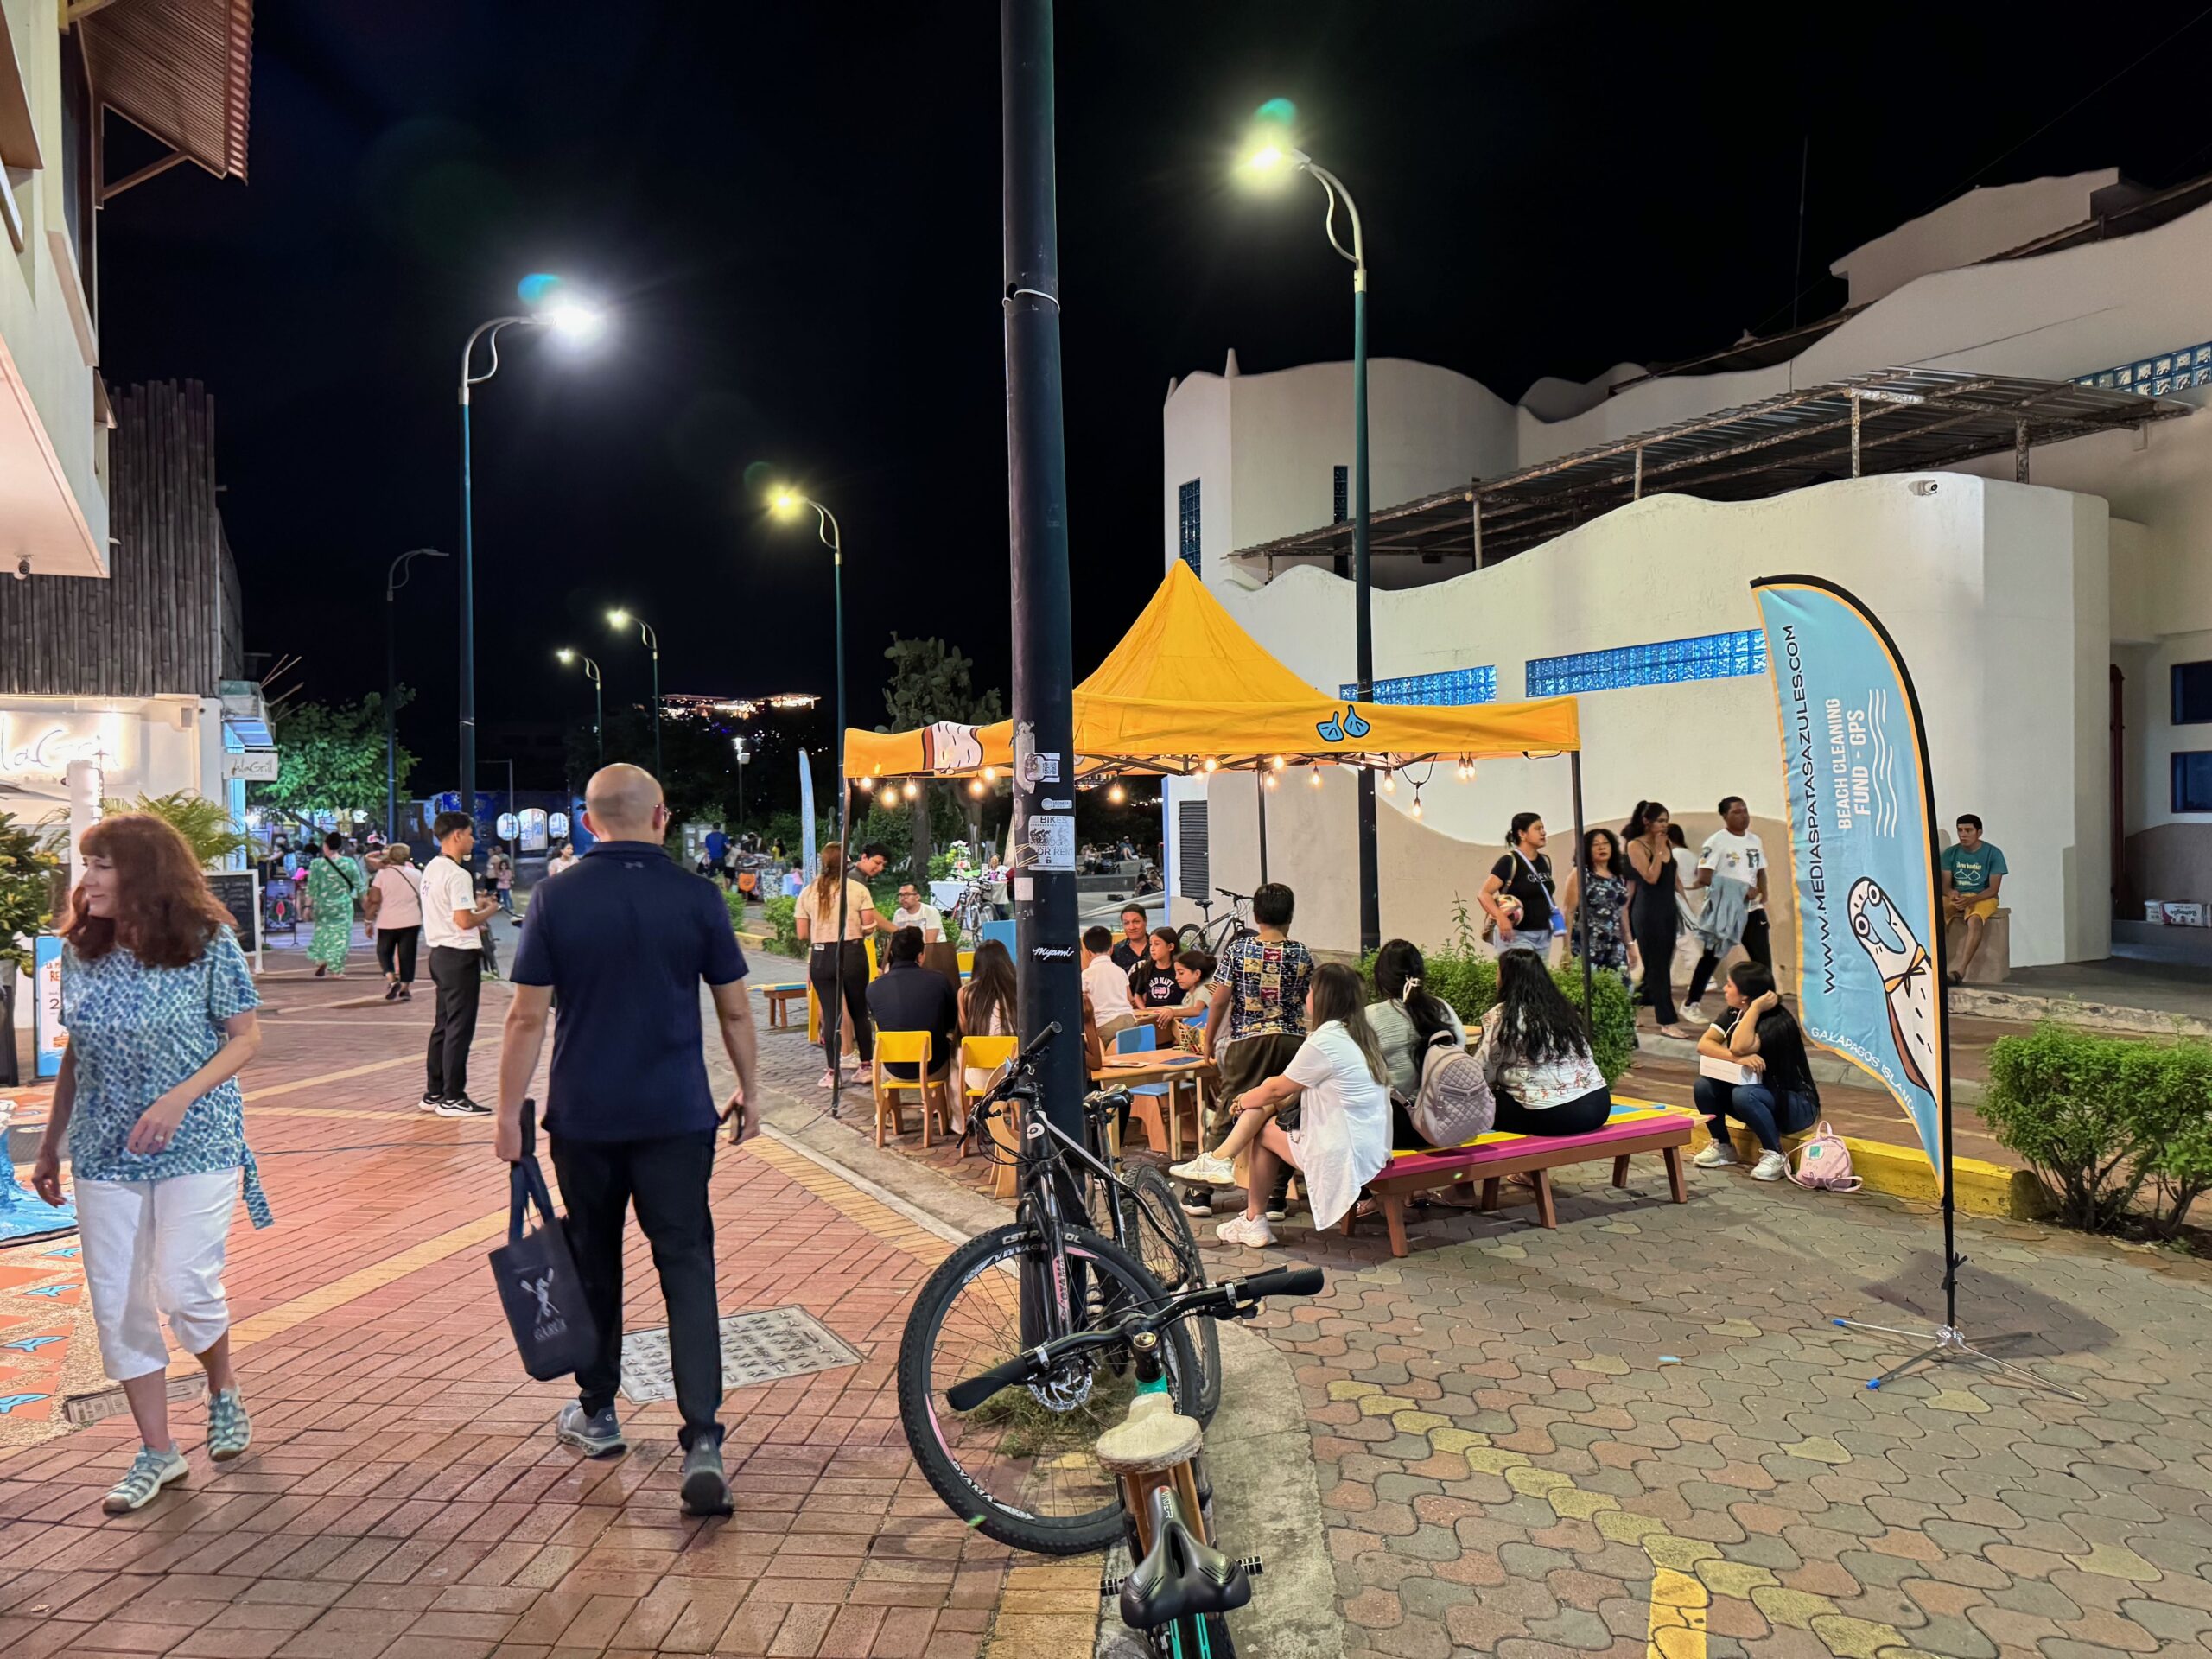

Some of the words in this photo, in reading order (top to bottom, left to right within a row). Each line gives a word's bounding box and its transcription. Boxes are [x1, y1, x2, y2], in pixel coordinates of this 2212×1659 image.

[1825, 697, 1847, 774] CLEANING
[1846, 709, 1867, 746] GPS
[1782, 625, 1836, 994] WWW.MEDIASPATASAZULES.COM
[1834, 777, 1853, 830] BEACH
[1851, 765, 1872, 816] FUND
[1039, 816, 1068, 824] BIKES
[1001, 1231, 1027, 1245] CST
[1029, 1230, 1083, 1244] POL
[952, 1460, 994, 1503] OYAMA
